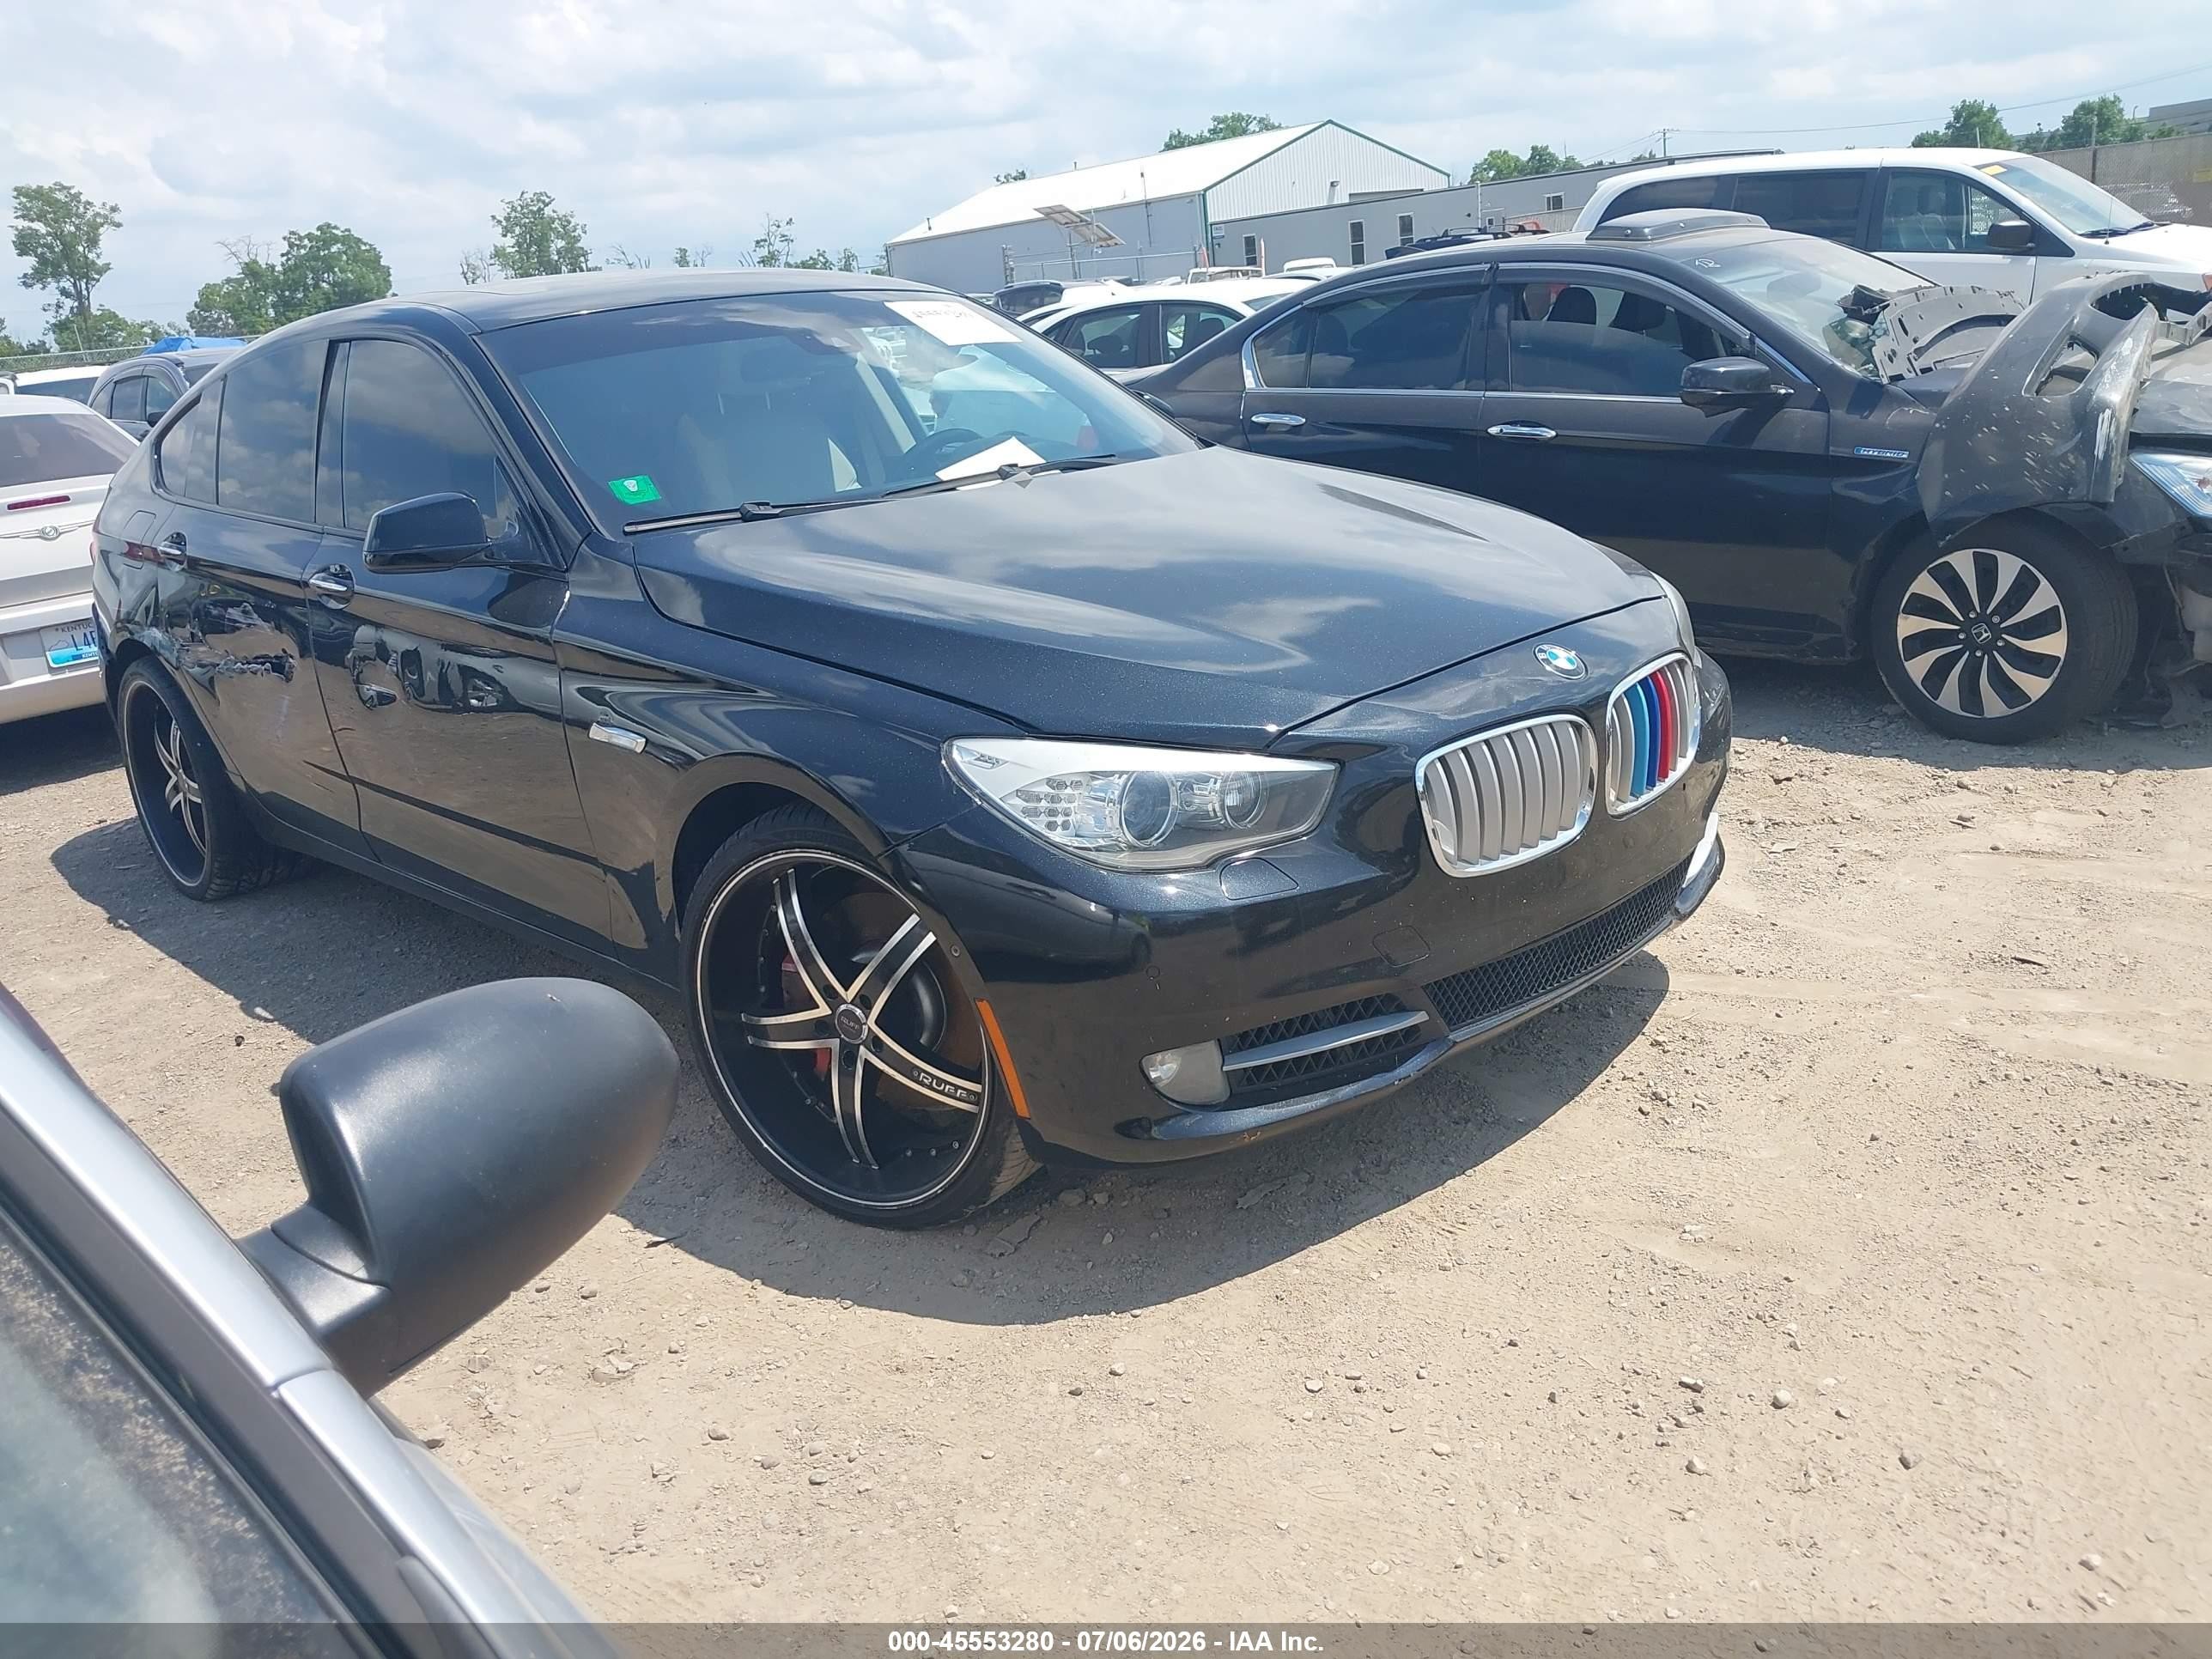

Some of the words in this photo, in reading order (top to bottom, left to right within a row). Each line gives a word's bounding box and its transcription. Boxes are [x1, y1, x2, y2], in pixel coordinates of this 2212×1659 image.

[1860, 448, 1906, 458] HYBRID
[61, 623, 93, 633] KENTUC
[919, 1072, 968, 1097] RUFF
